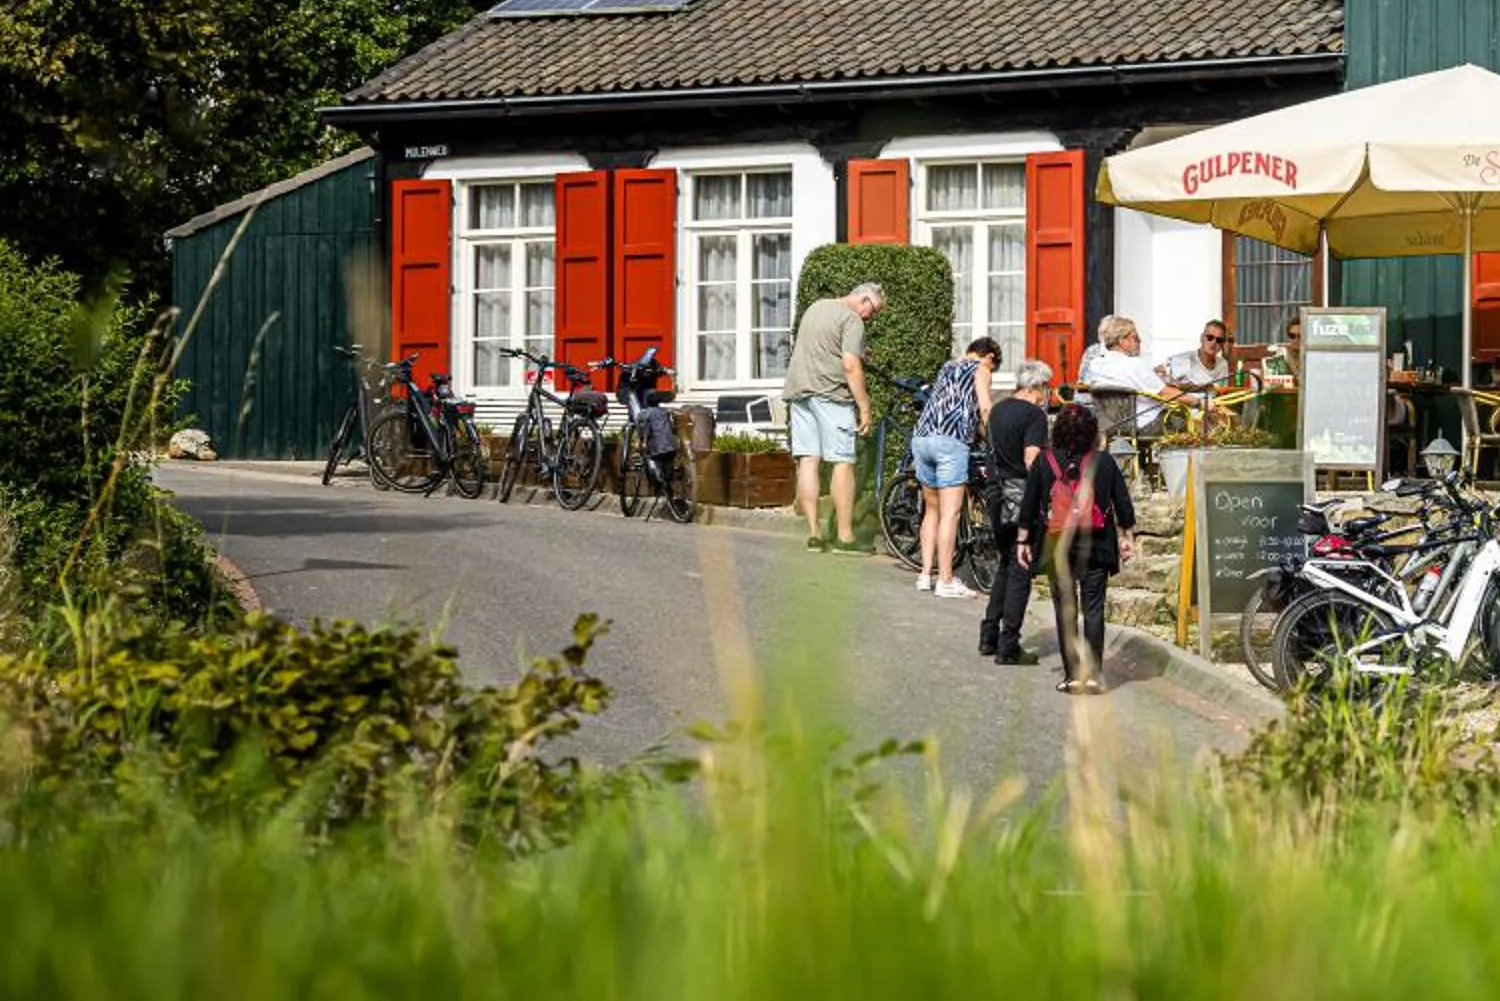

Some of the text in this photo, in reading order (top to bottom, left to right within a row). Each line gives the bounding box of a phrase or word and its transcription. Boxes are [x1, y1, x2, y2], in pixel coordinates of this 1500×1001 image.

[1183, 151, 1297, 195] GULPENER
[1312, 320, 1348, 336] fuze
[1215, 490, 1263, 512] Open
